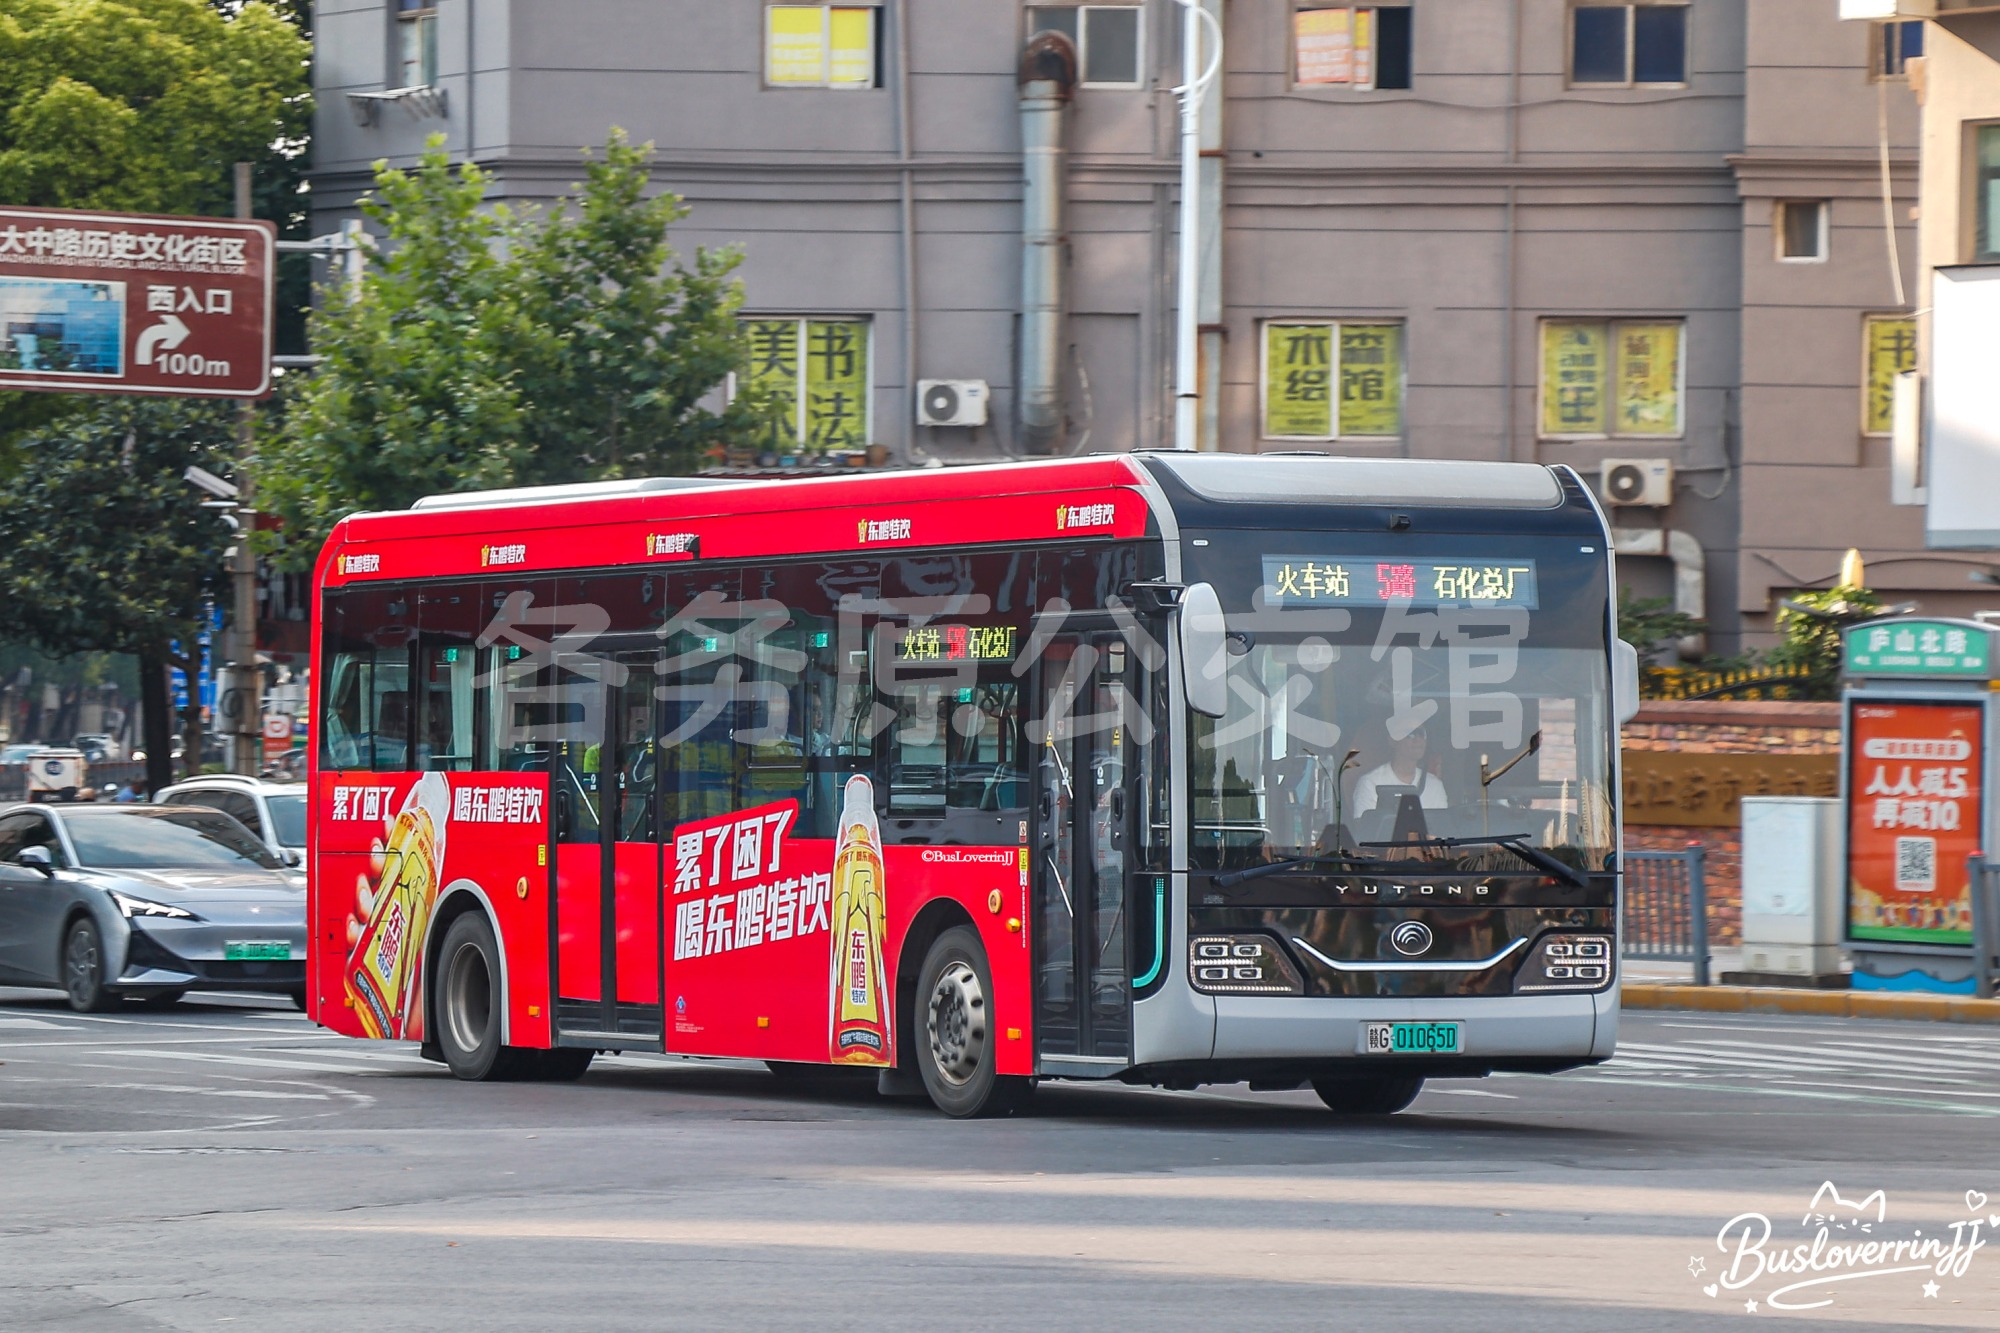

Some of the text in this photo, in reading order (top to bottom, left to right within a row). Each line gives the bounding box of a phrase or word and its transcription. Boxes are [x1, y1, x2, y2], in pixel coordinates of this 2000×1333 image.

[0, 225, 247, 264] 大中路历史文化街区
[147, 285, 233, 314] 西入口
[154, 354, 231, 377] 100m
[868, 519, 911, 541] 东鹏特饮
[1067, 504, 1115, 528] 东鹏特饮
[345, 554, 380, 573] 东鹏特饮
[489, 544, 526, 564] 东鹏特饮
[1275, 562, 1530, 599] 火车站 5路 石化总厂
[902, 629, 940, 661] 火车站
[969, 626, 1017, 659] 石化总厂
[1868, 628, 1967, 654] 庐山北路
[332, 786, 396, 821] 累了困了
[453, 786, 542, 823] 喝东鹏特饮
[673, 808, 795, 895] 累了困了
[1335, 885, 1490, 895] YUTONG
[673, 871, 832, 961] 喝东鹏特饮
